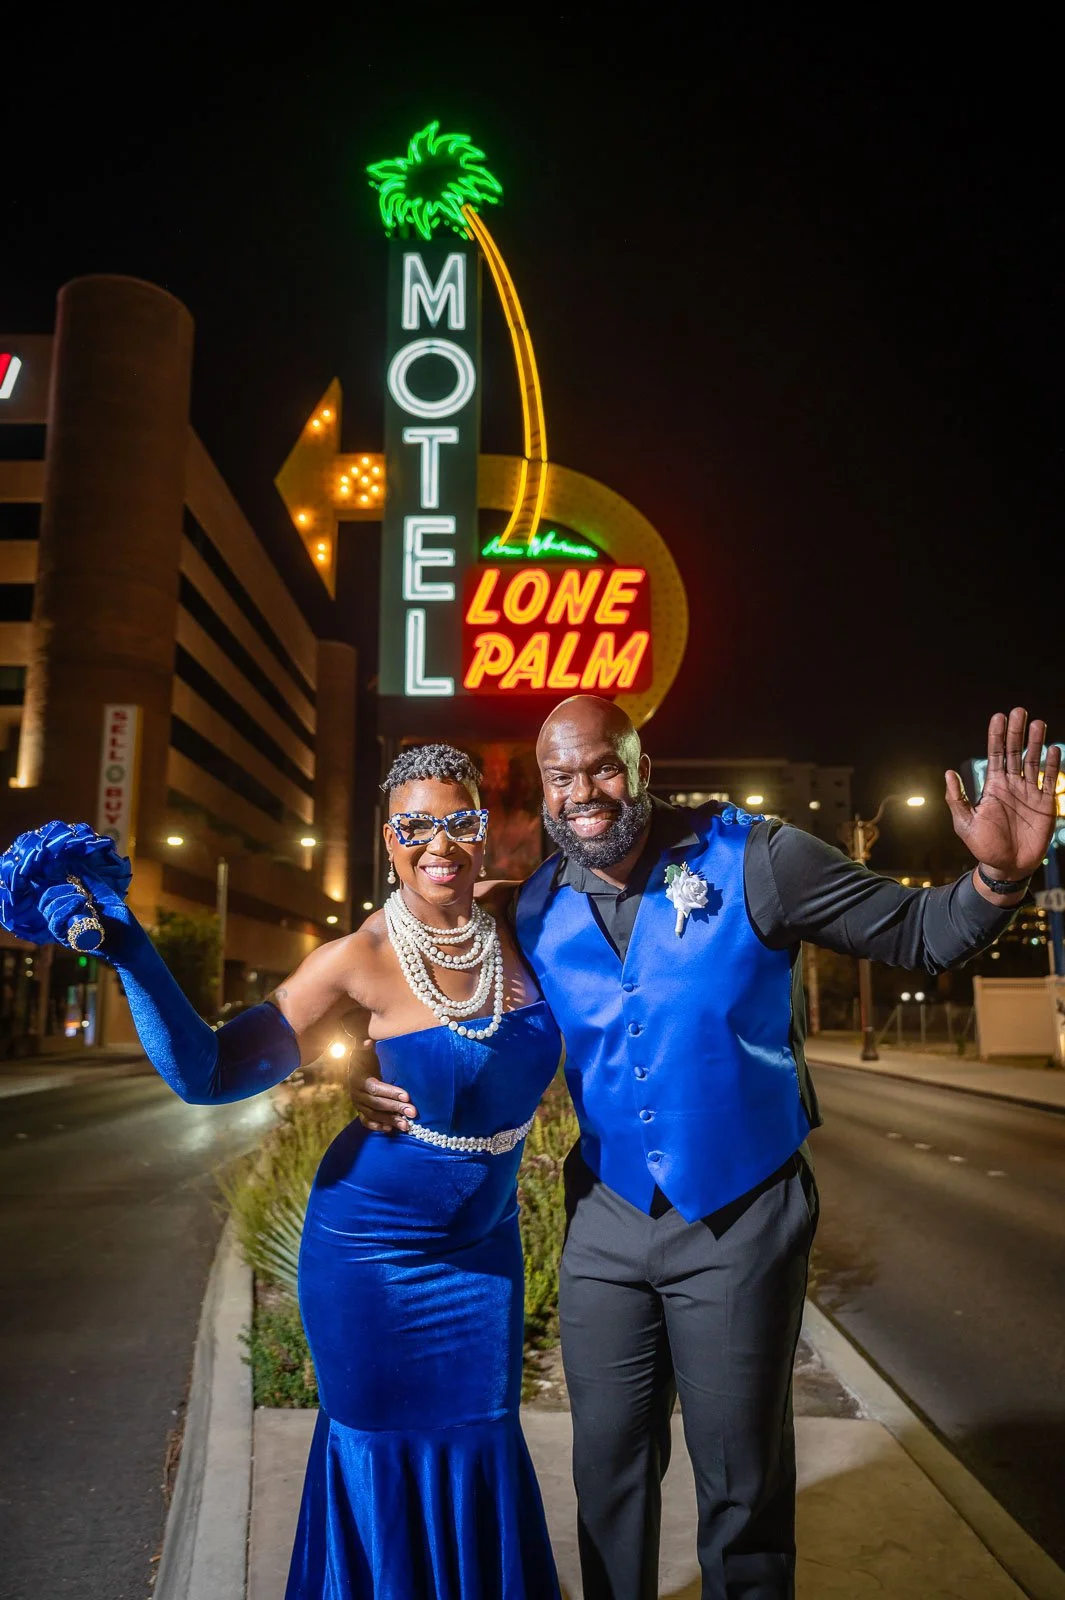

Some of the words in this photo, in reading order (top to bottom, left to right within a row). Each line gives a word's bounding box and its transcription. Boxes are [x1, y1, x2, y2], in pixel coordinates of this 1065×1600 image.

[386, 252, 476, 697] MOTEL
[465, 568, 646, 625] LONE
[463, 631, 649, 689] PALM
[104, 786, 123, 825] BUY
